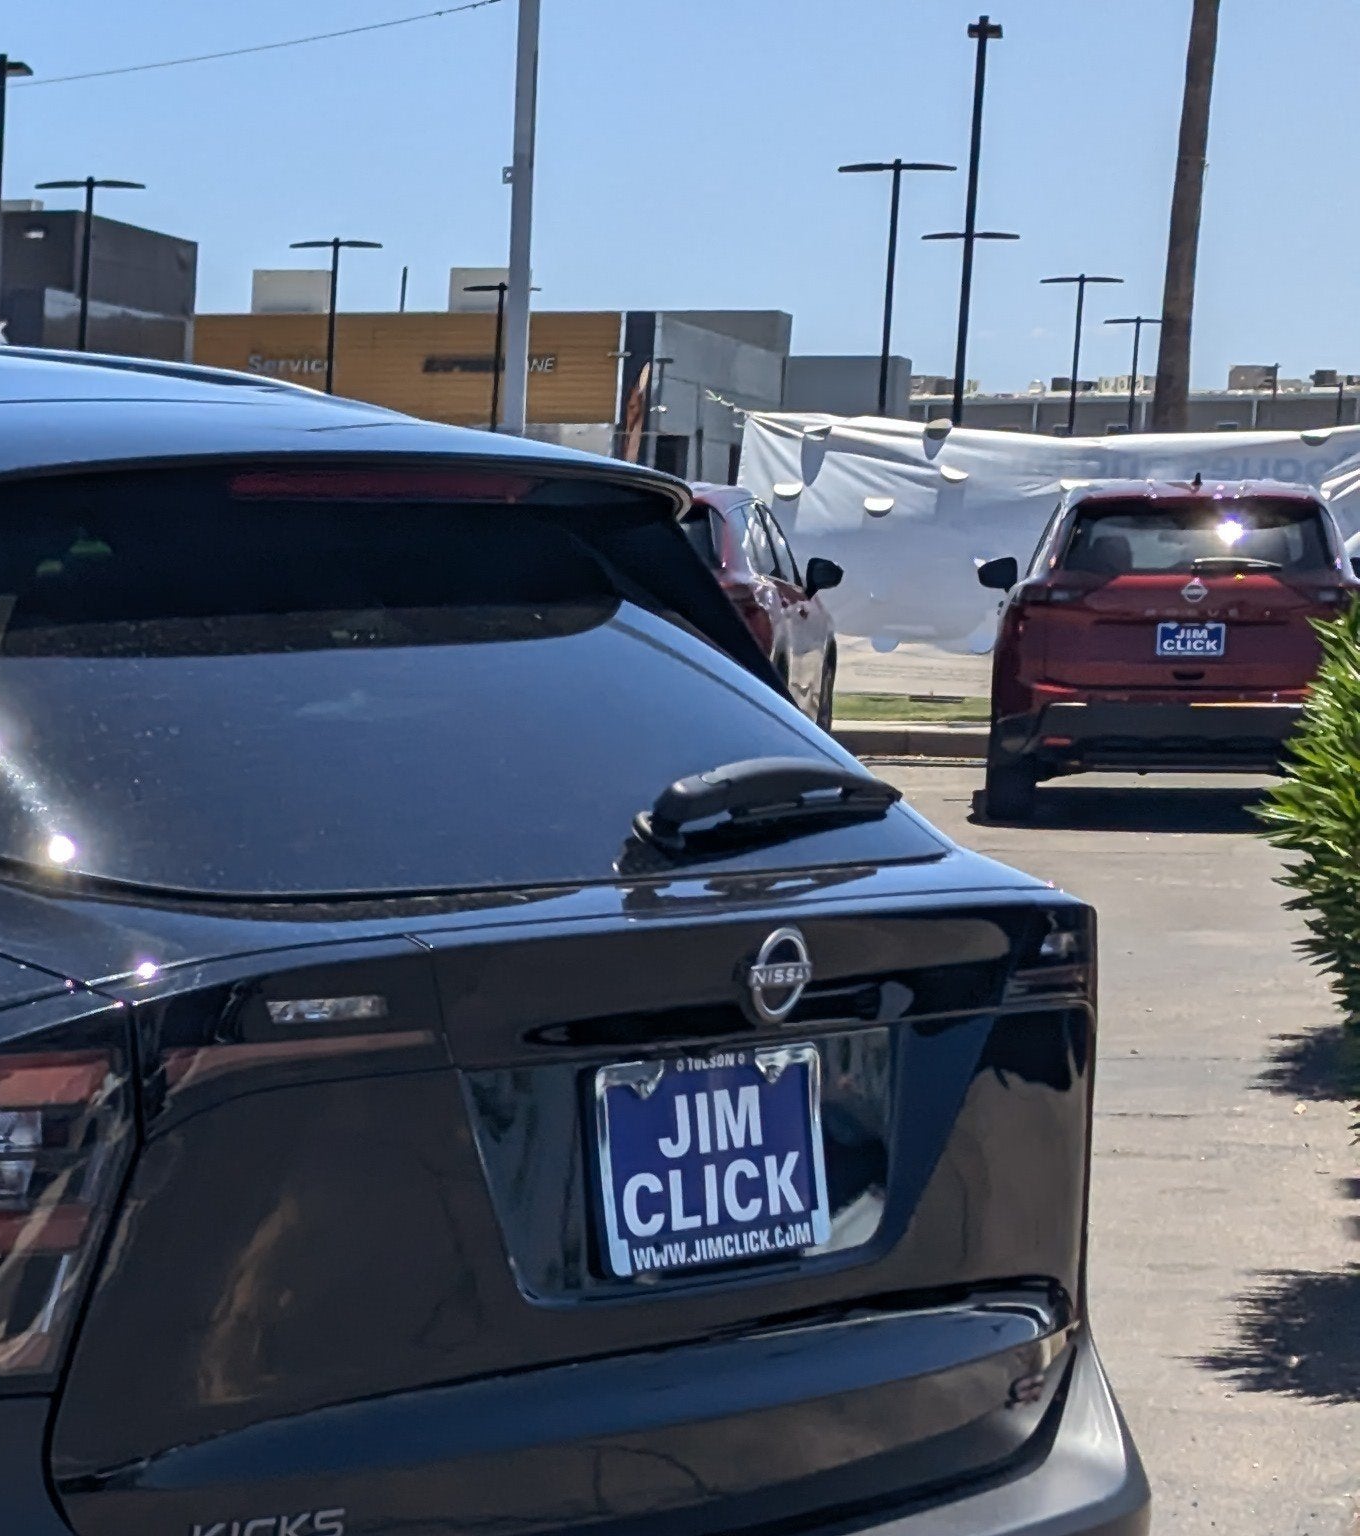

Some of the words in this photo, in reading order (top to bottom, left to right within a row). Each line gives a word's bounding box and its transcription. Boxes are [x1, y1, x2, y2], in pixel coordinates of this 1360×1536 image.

[1162, 639, 1219, 652] CLICK
[1175, 628, 1209, 640] JIM
[658, 1084, 764, 1159] JIM
[622, 1150, 805, 1238] CLICK
[632, 1221, 812, 1272] WWW.JIMCLICK.COM
